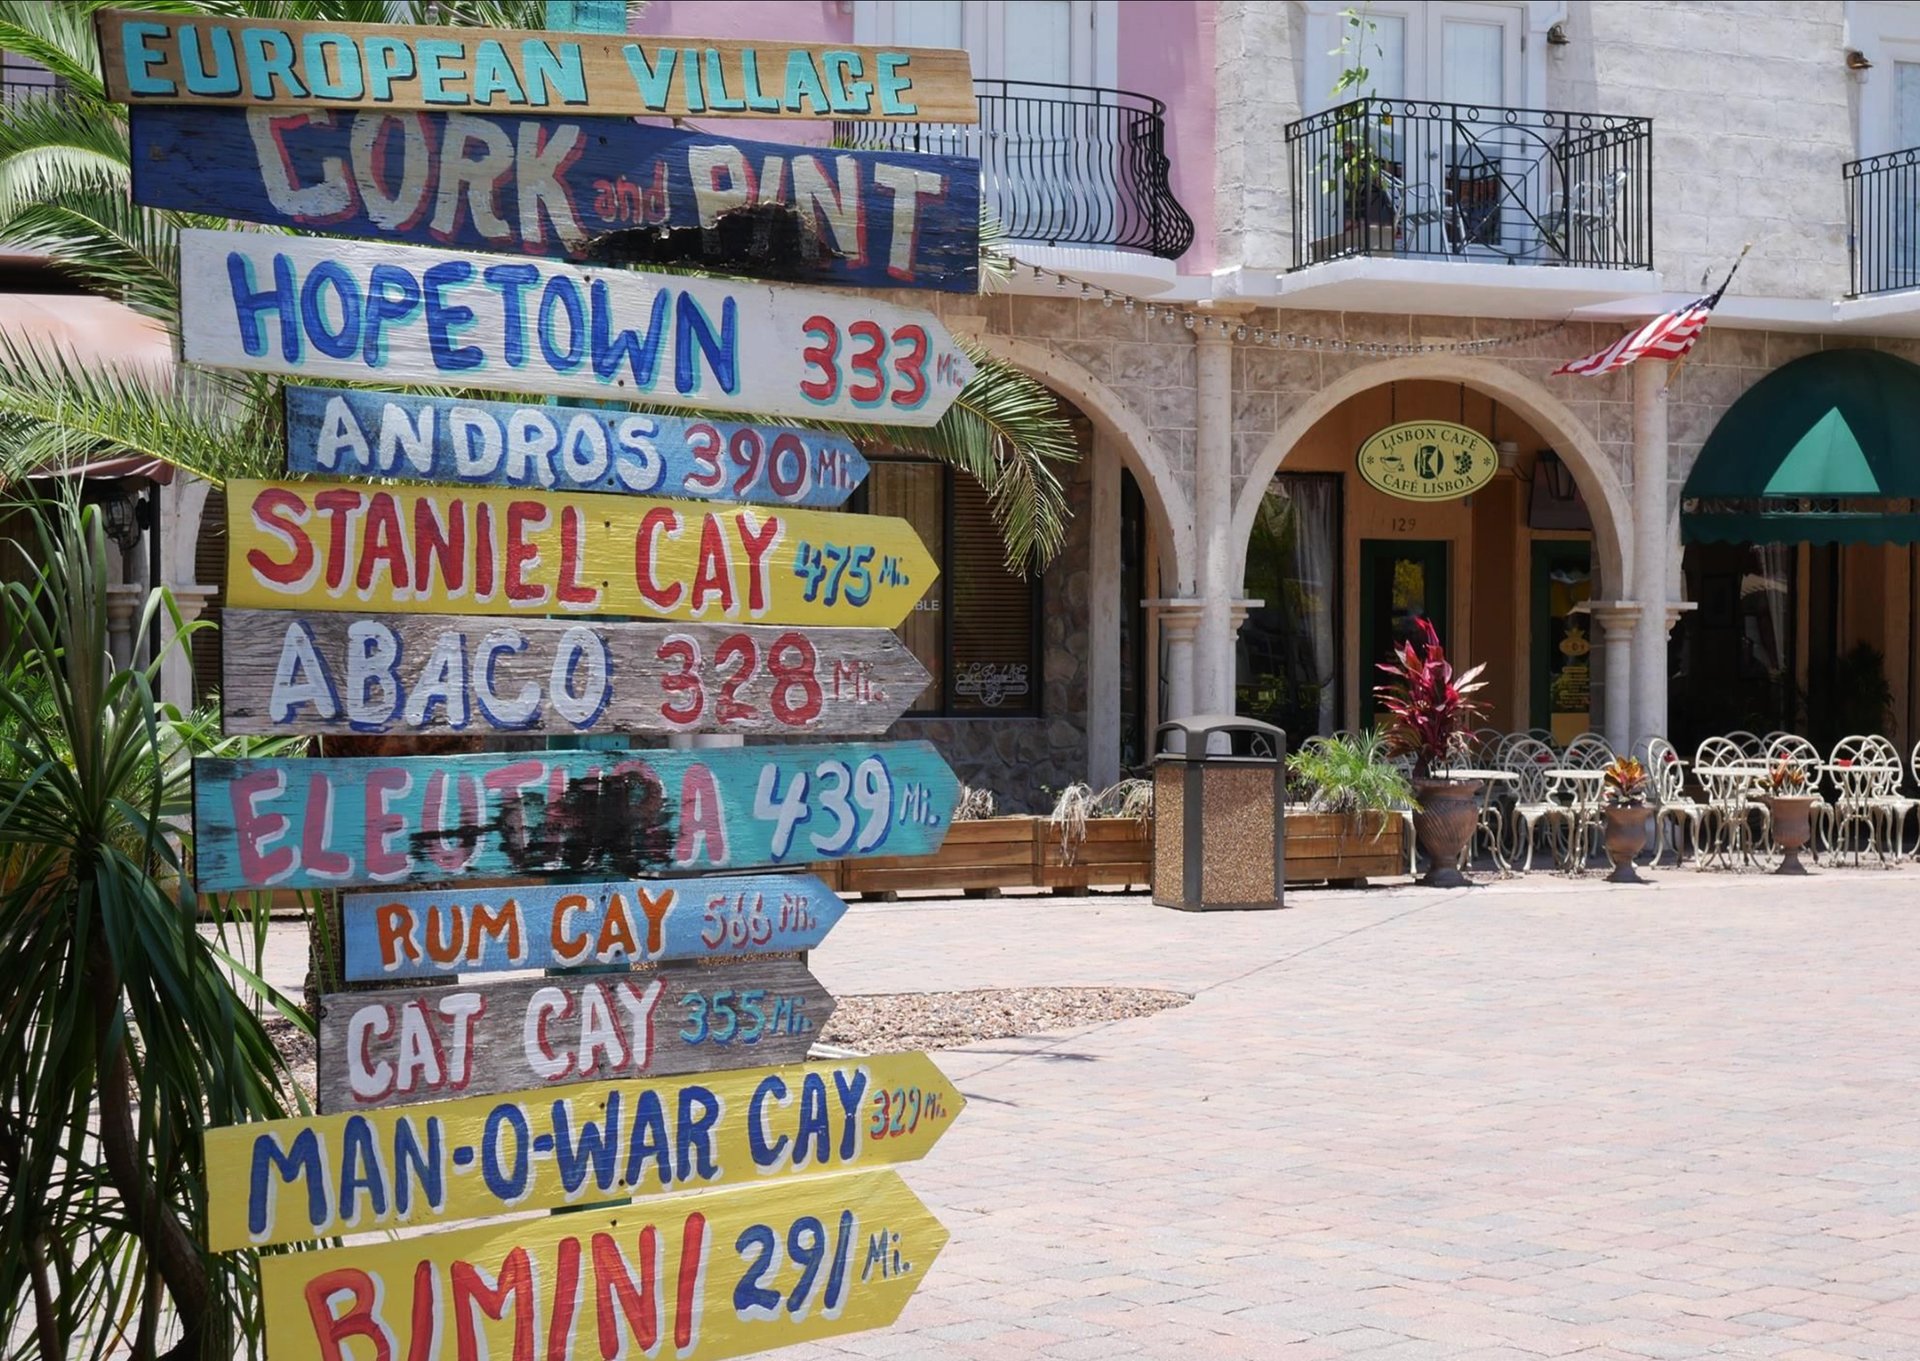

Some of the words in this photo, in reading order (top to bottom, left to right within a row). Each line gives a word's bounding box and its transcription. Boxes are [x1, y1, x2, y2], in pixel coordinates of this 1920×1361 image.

[122, 20, 590, 107] EUROPEAN
[622, 43, 920, 116] VILLAGE
[245, 107, 588, 260] CORK
[593, 159, 669, 225] and
[688, 144, 949, 282] PINT
[227, 251, 742, 398] HOPETOWN
[799, 314, 935, 410] 333
[315, 394, 668, 495] ANDROS
[683, 422, 812, 503] 390
[1381, 428, 1437, 450] LISBON
[1440, 429, 1479, 451] CAFÉ
[1382, 473, 1418, 494] CAFÉ
[1422, 475, 1475, 494] LISBOA
[247, 487, 602, 612] STANIEL
[635, 505, 787, 619] CAY
[791, 541, 877, 607] 475
[1391, 518, 1417, 532] 129
[269, 620, 614, 731] ABACO
[656, 631, 825, 727] 328
[752, 752, 895, 863] 439
[374, 899, 529, 971] RUM
[550, 887, 677, 970] CAY
[701, 892, 773, 951] 566
[346, 991, 488, 1103] CAT
[523, 975, 667, 1081] CAY
[678, 990, 767, 1047] 355
[247, 1084, 726, 1245] MAN-O-WAR
[746, 1063, 871, 1173] CAY
[867, 1086, 922, 1141] 329
[304, 1211, 713, 1361] BIMINI
[732, 1207, 859, 1323] 291
